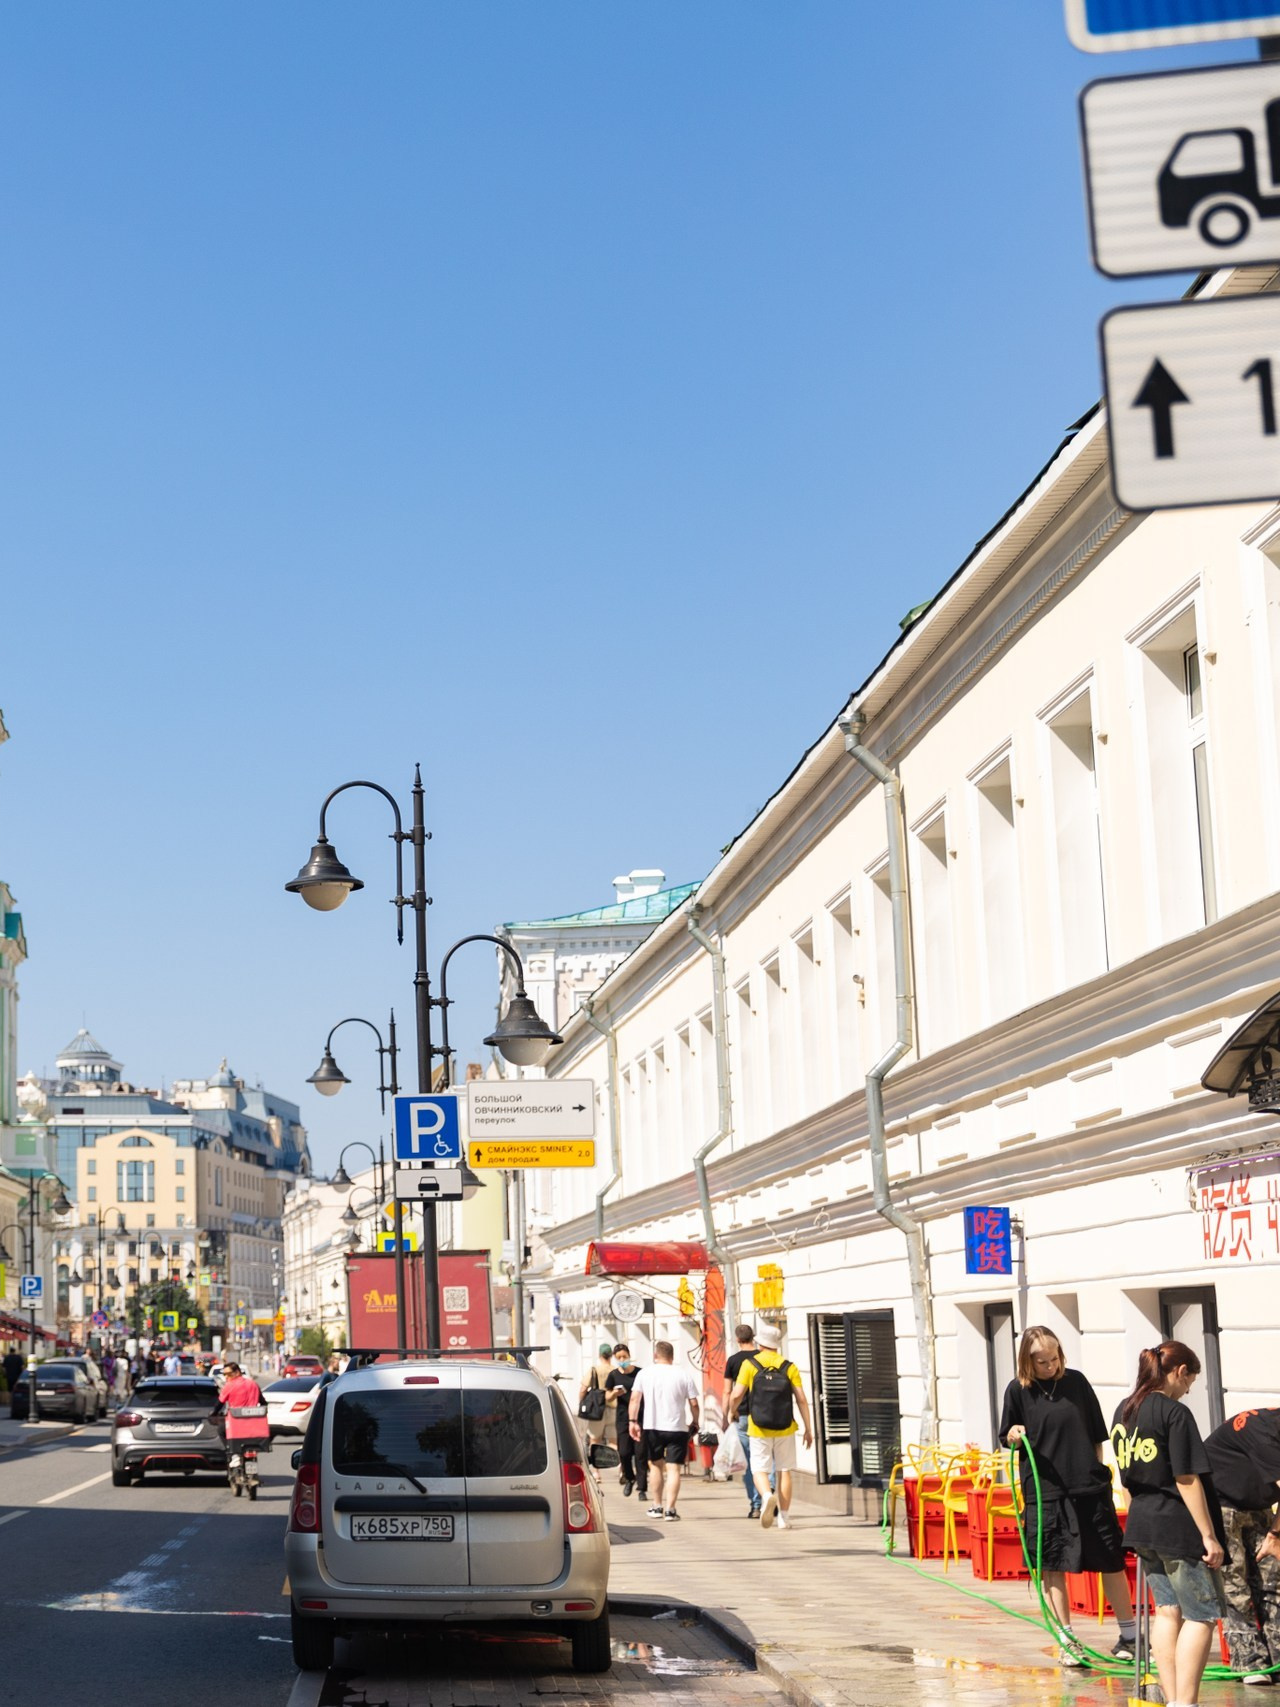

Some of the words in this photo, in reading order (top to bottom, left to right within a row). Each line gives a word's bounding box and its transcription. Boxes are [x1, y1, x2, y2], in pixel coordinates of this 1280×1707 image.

[474, 1094, 523, 1104] БОЛЬШОЙ
[474, 1104, 563, 1115] ОВЧИННИКОВСКИЙ
[474, 1117, 516, 1125] переулок
[409, 1102, 446, 1154] P
[487, 1145, 537, 1154] СМАЙНЭКС
[540, 1145, 574, 1153] SMINEX
[578, 1150, 591, 1158] 2.0
[507, 1156, 540, 1164] продаж
[973, 1209, 1007, 1272] 吃货
[334, 1481, 407, 1491] LADA
[423, 1517, 449, 1531] 750
